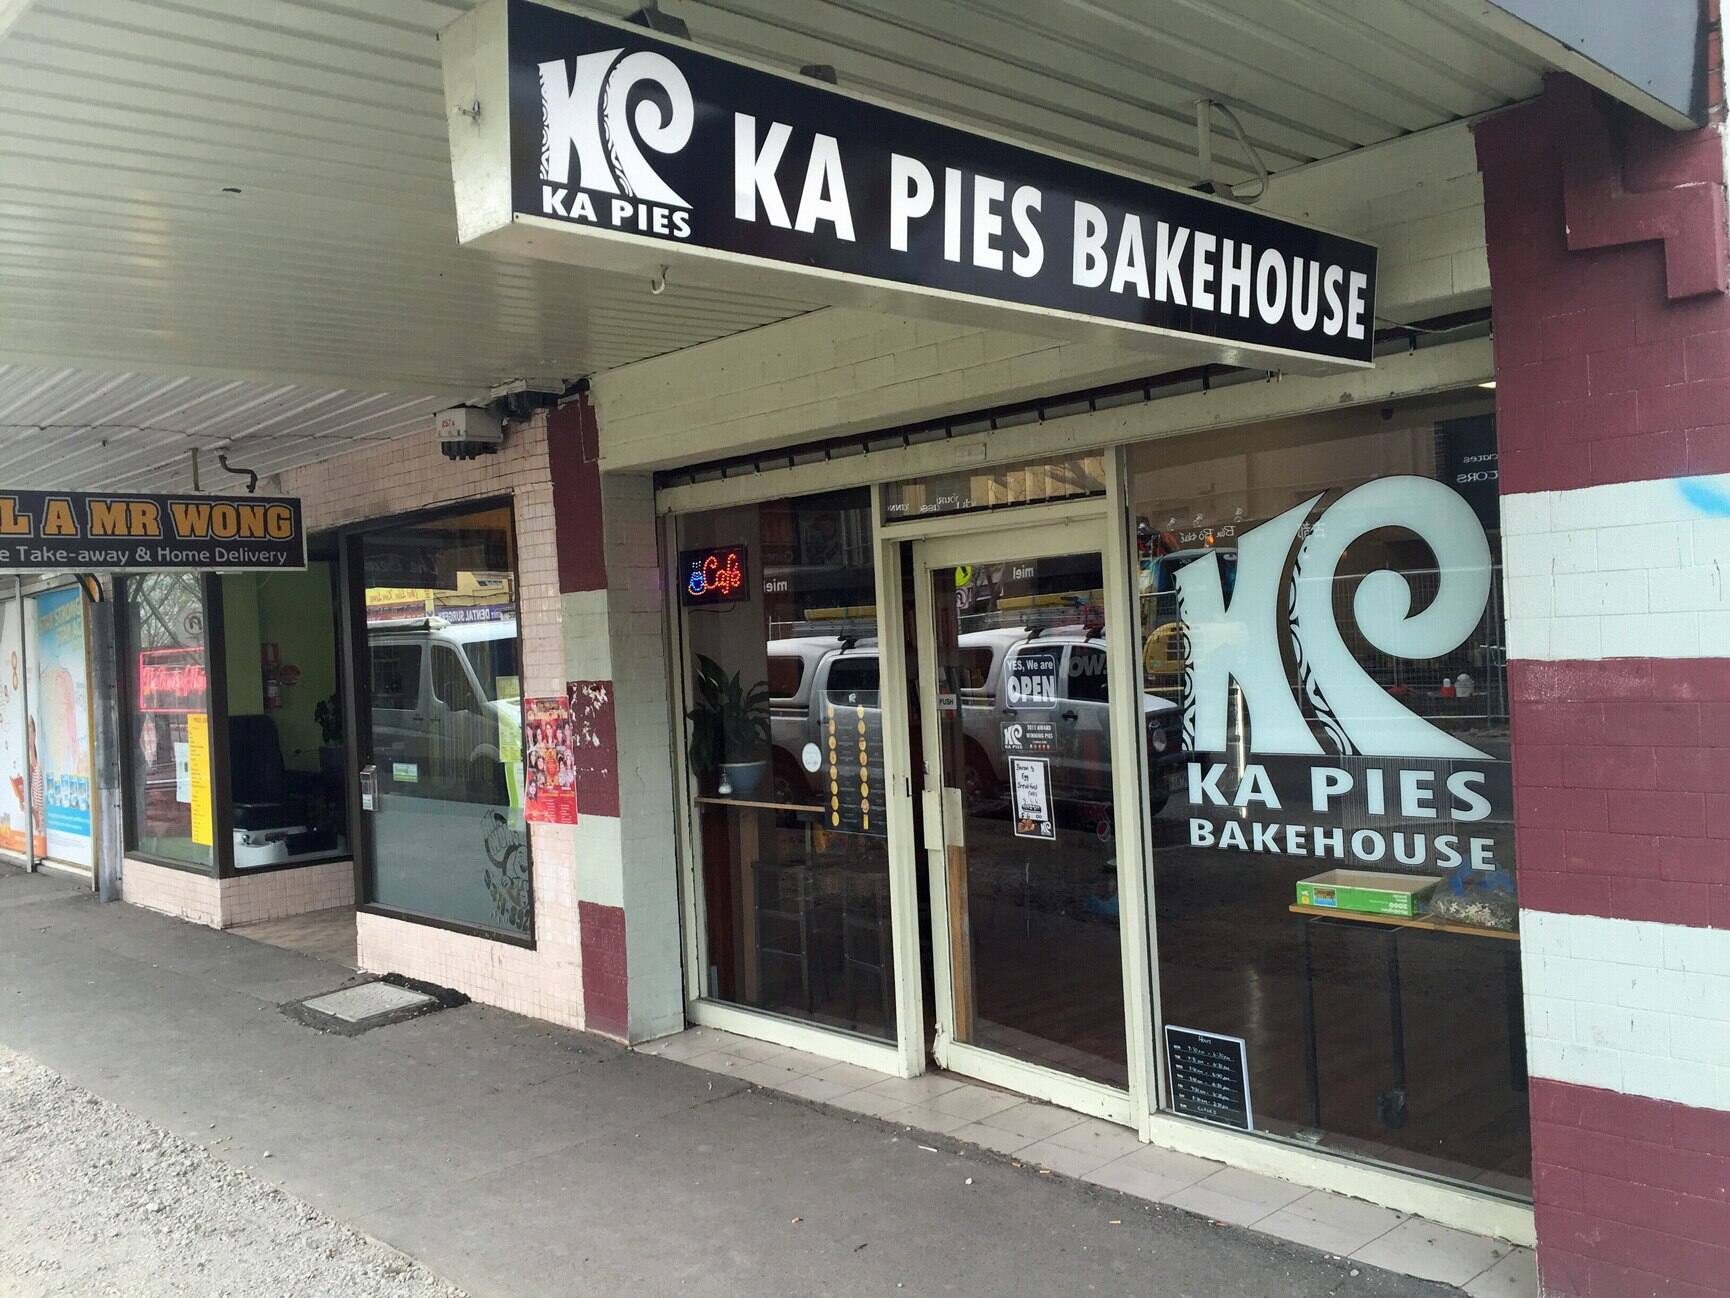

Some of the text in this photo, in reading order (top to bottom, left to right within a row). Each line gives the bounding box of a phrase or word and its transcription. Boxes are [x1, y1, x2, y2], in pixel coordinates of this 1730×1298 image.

[542, 185, 692, 239] KA PIES
[735, 112, 1368, 340] KA PIES BAKEHOUSE
[41, 497, 80, 538] A
[86, 498, 163, 539] MR
[168, 500, 294, 541] WONG
[16, 546, 128, 565] Take-away
[135, 547, 152, 562] &
[158, 547, 210, 562] Home
[215, 547, 287, 566] Delivery
[1006, 660, 1053, 672] YES, We are
[1007, 675, 1055, 703] OPEN
[1187, 762, 1492, 822] KA PIES
[1189, 818, 1497, 871] BAKEHOUSE
